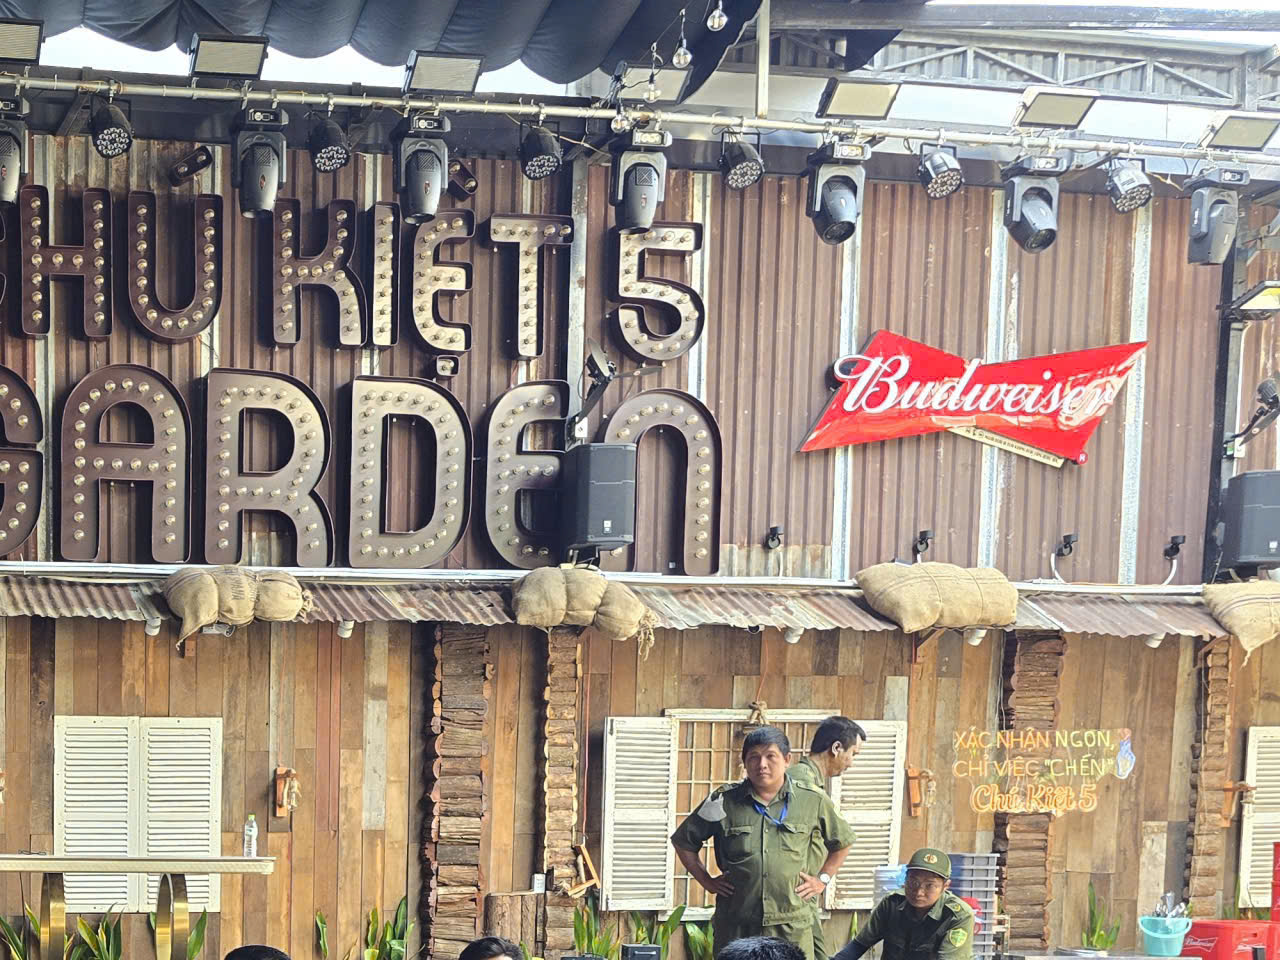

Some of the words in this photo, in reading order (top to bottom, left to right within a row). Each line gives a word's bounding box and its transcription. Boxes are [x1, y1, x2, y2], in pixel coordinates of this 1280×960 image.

[614, 221, 705, 362] 5
[833, 354, 1115, 414] Budweiser
[996, 727, 1049, 752] NHẬN
[952, 754, 988, 777] CHỈ
[1078, 784, 1098, 813] 5
